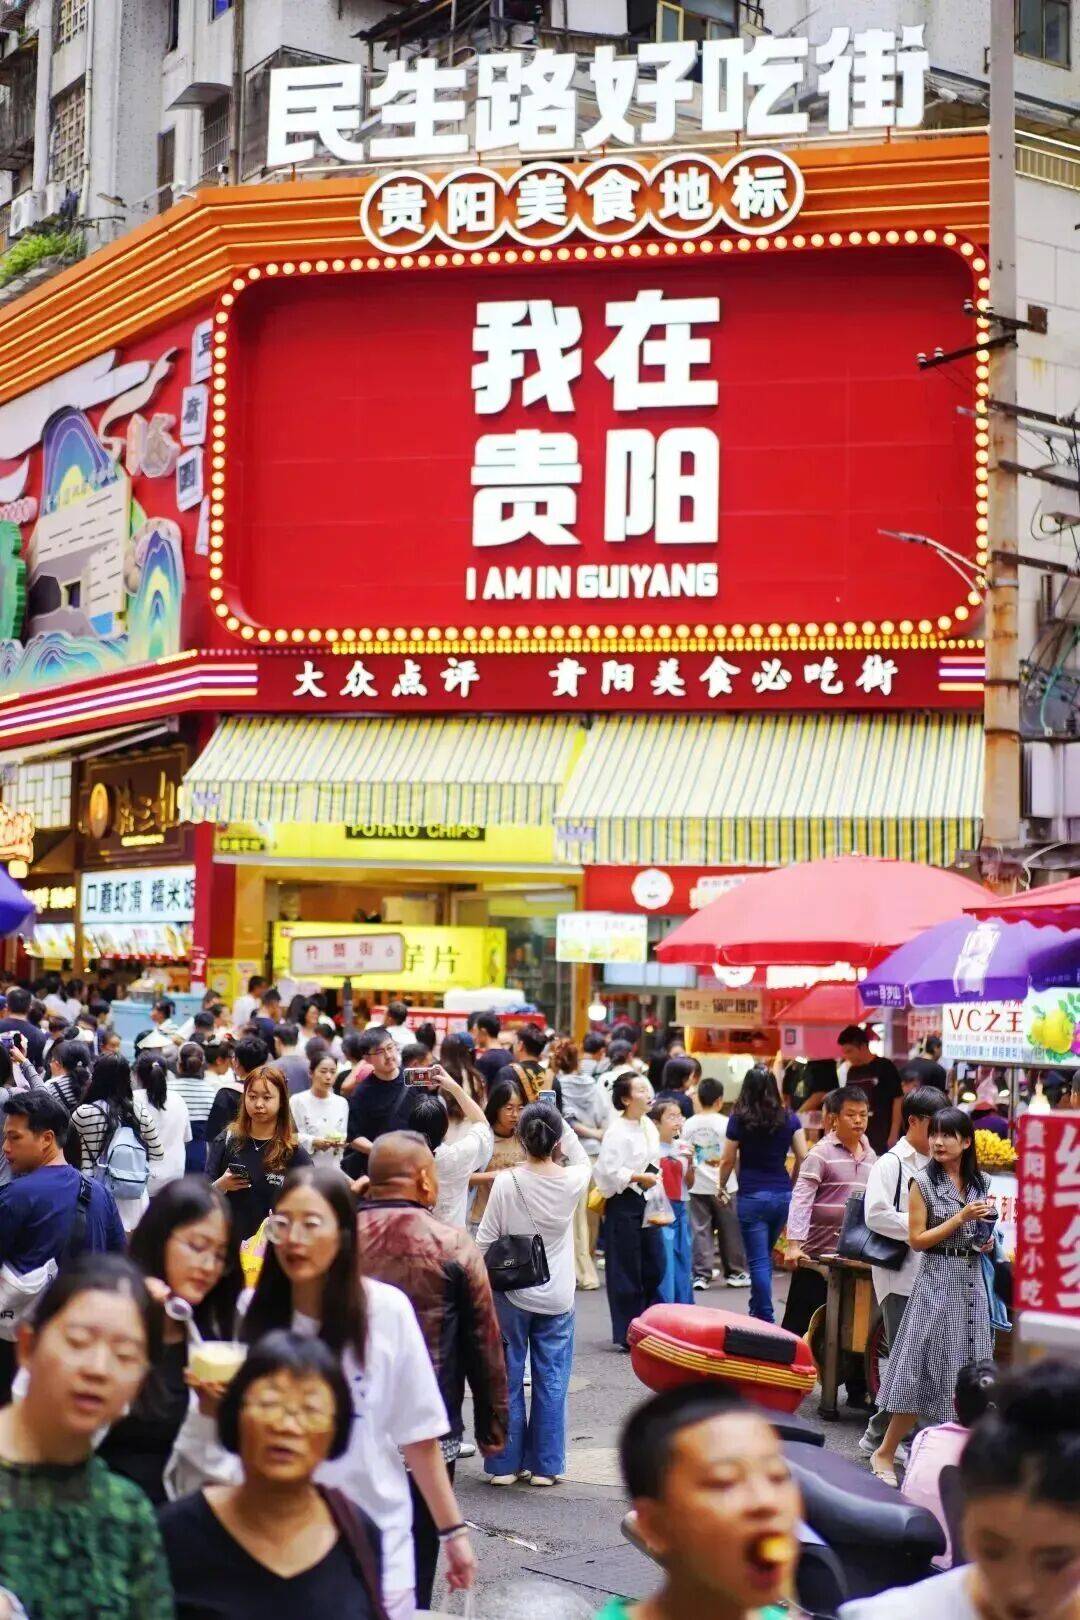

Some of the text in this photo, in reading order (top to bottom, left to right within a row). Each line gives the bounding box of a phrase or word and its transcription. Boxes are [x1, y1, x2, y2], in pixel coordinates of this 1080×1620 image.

[265, 23, 929, 166] 民生路好吃街
[377, 166, 790, 237] 贵阳美食地标
[471, 289, 720, 414] 我在
[470, 427, 720, 547] 贵阳
[466, 563, 718, 600] I AM IN GUIYANG
[292, 654, 898, 698] 大众点评 贵阳美食必吃街
[351, 824, 480, 839] POTATO CHIPS
[948, 1007, 1025, 1033] VC之王
